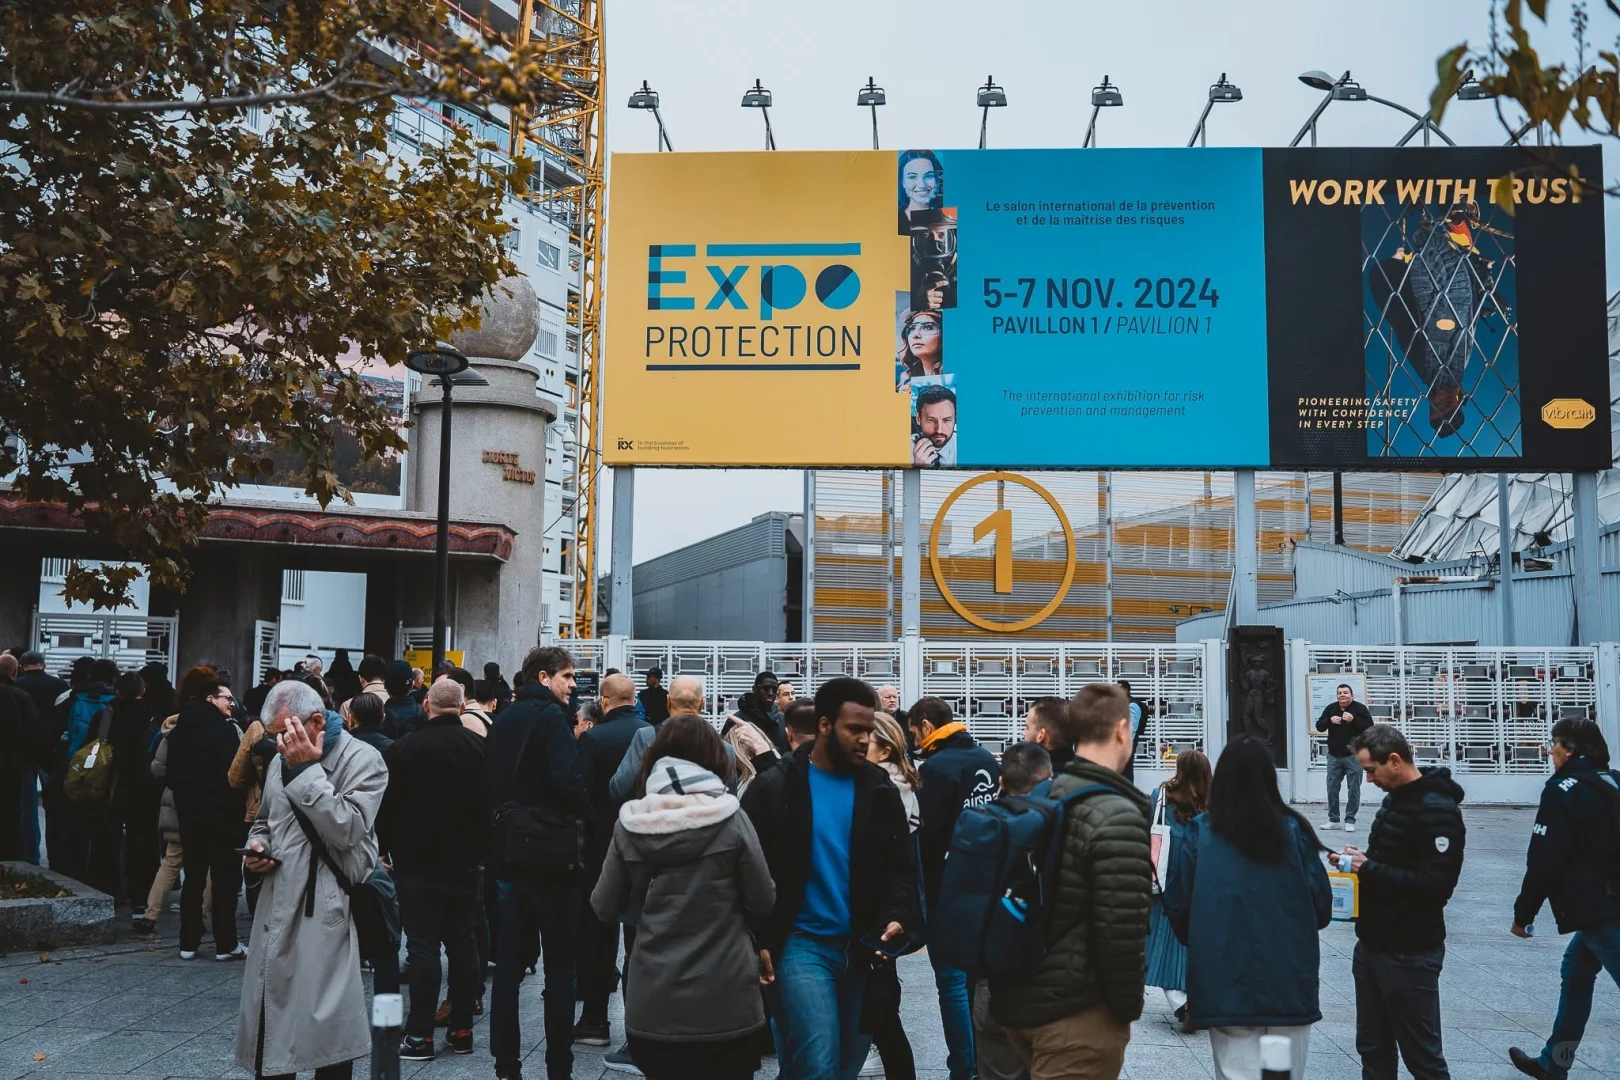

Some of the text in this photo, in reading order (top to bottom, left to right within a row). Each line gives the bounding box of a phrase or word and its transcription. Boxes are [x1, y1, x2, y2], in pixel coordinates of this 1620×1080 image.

[1289, 179, 1388, 205] WORK
[1396, 179, 1477, 205] WITH
[986, 199, 1215, 214] Le salon international de la prévention
[1016, 214, 1185, 227] et de la maîtrise des risques
[648, 243, 861, 320] Expo
[983, 278, 1219, 309] 5-7 NOV. 2024
[992, 316, 1212, 334] PAVILLON 1 / PAVILION 1
[646, 325, 861, 357] PROTECTION
[1002, 390, 1205, 401] The international exhibition for risk
[1298, 397, 1419, 406] PIONEERING SAFETY
[1020, 405, 1186, 418] prevention and management
[1298, 408, 1408, 418] WITH CONFIDENCE
[1545, 405, 1594, 420] vibram
[1299, 420, 1384, 429] IN EVERY STEP
[482, 450, 519, 466] PORTE
[973, 509, 1013, 594] 1
